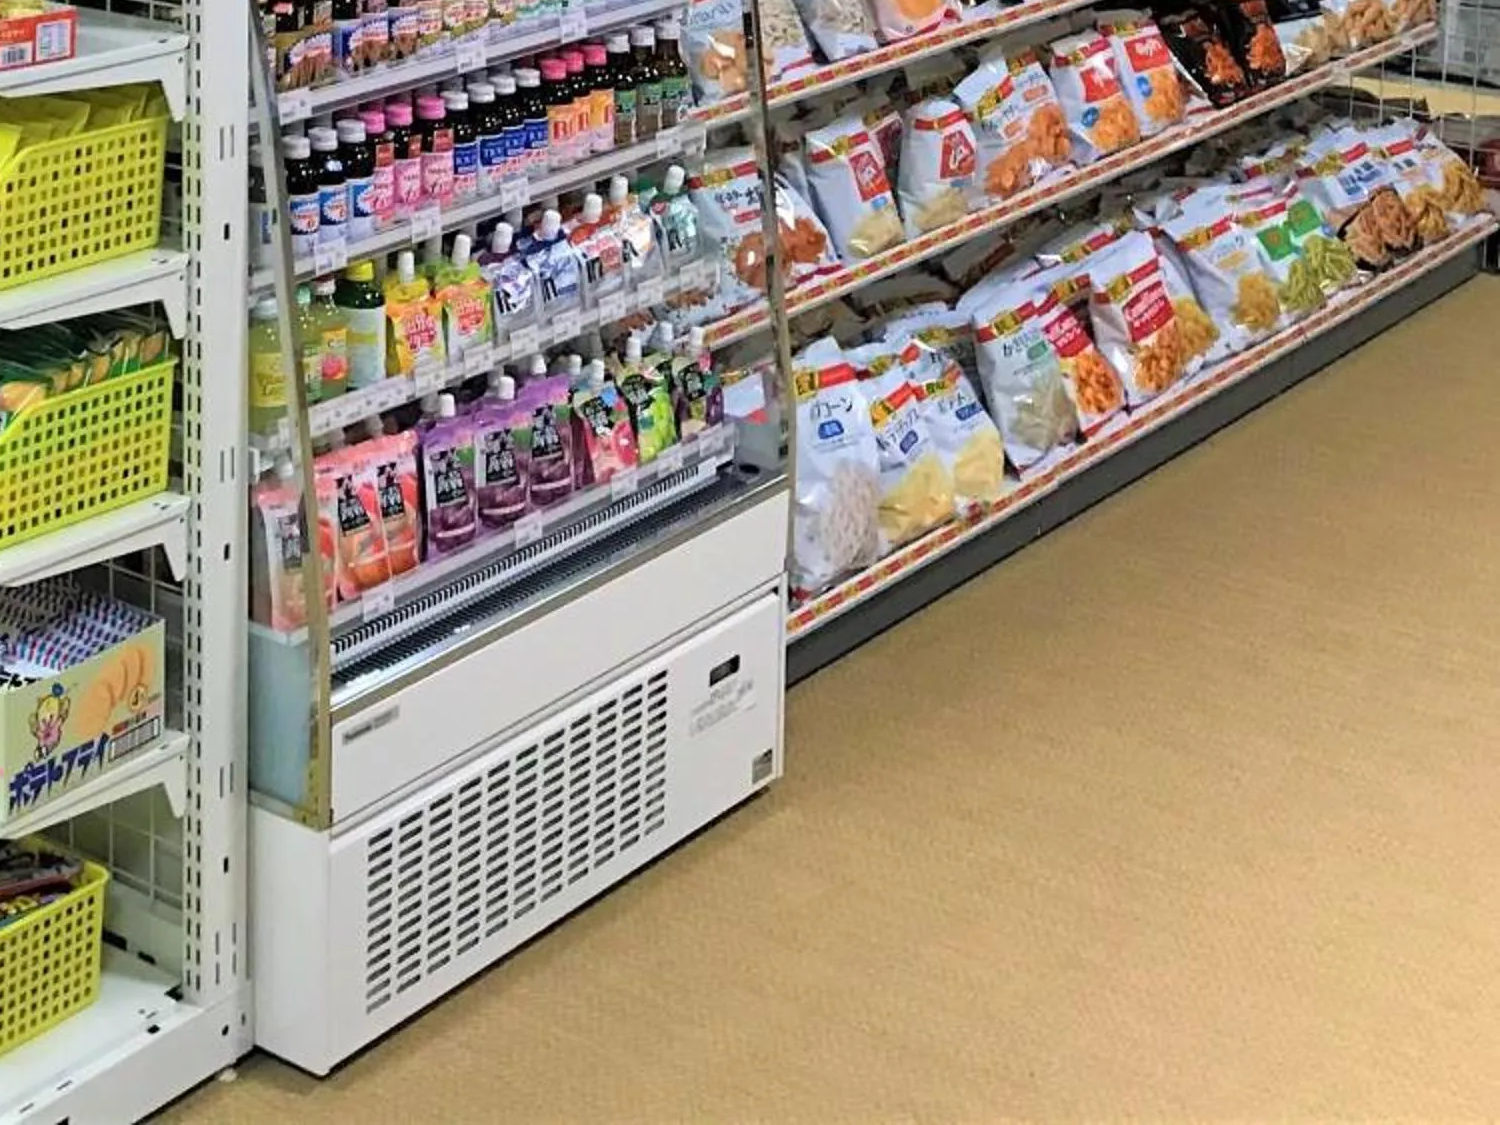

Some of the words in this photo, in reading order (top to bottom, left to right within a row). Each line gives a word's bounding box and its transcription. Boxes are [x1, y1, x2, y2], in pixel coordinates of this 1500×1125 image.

[8, 730, 110, 811] ポテトフライ
